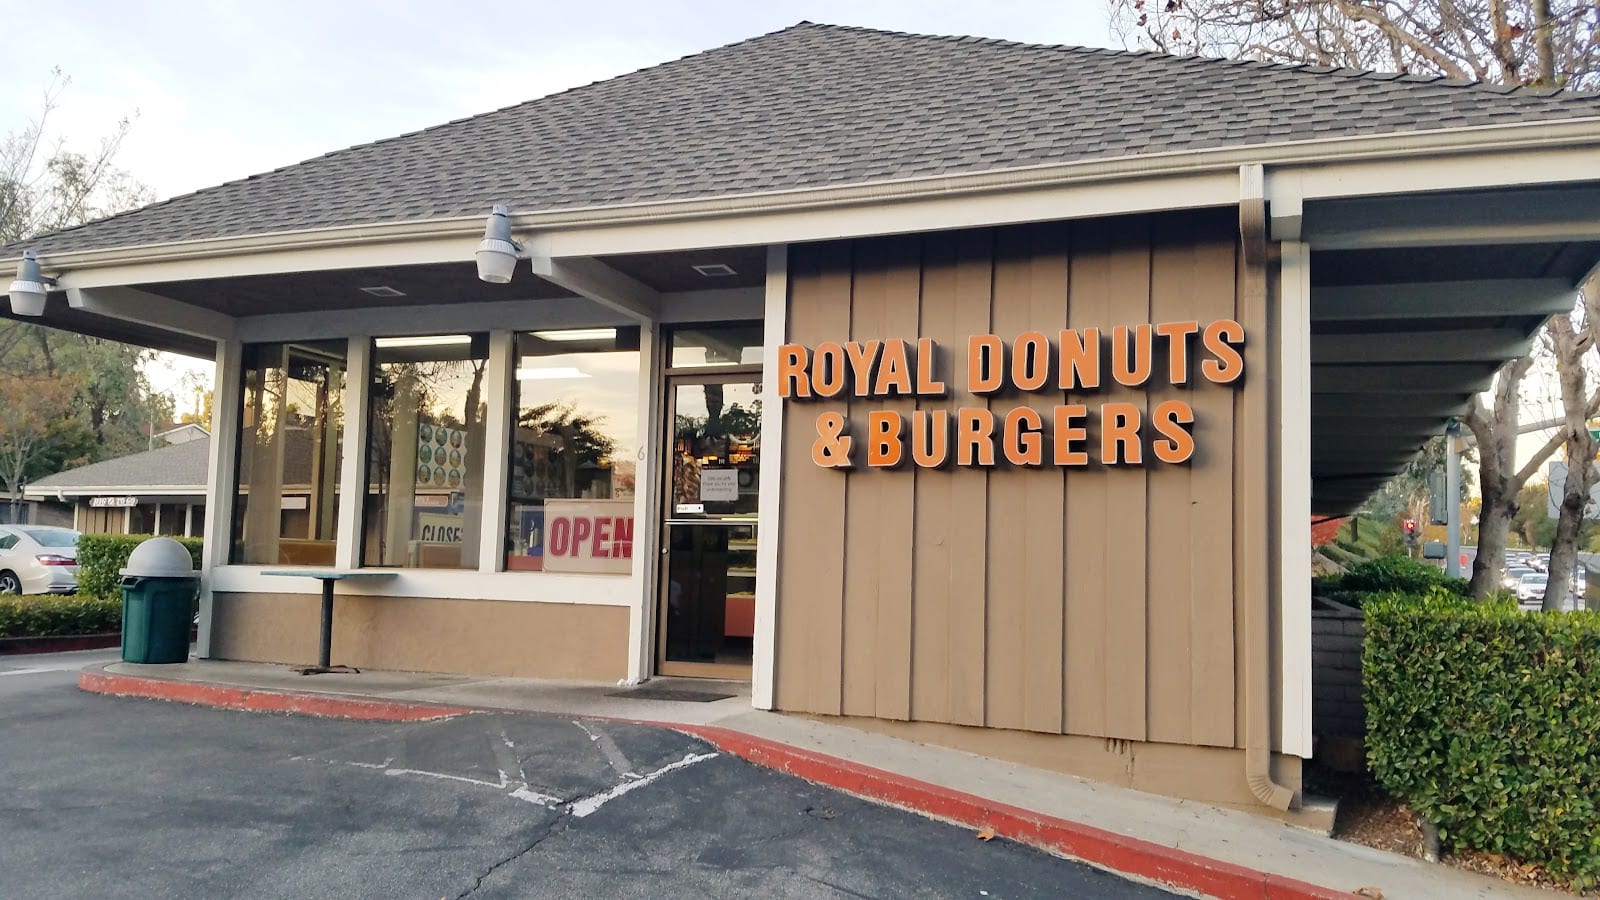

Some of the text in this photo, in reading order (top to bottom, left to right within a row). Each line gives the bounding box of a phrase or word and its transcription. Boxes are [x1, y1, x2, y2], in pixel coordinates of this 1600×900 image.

[777, 319, 1245, 398] ROYAL DONUTS
[637, 446, 645, 460] 6
[811, 401, 1195, 468] & BURGERS
[421, 524, 464, 542] CLOSE
[549, 516, 634, 558] OPEN
